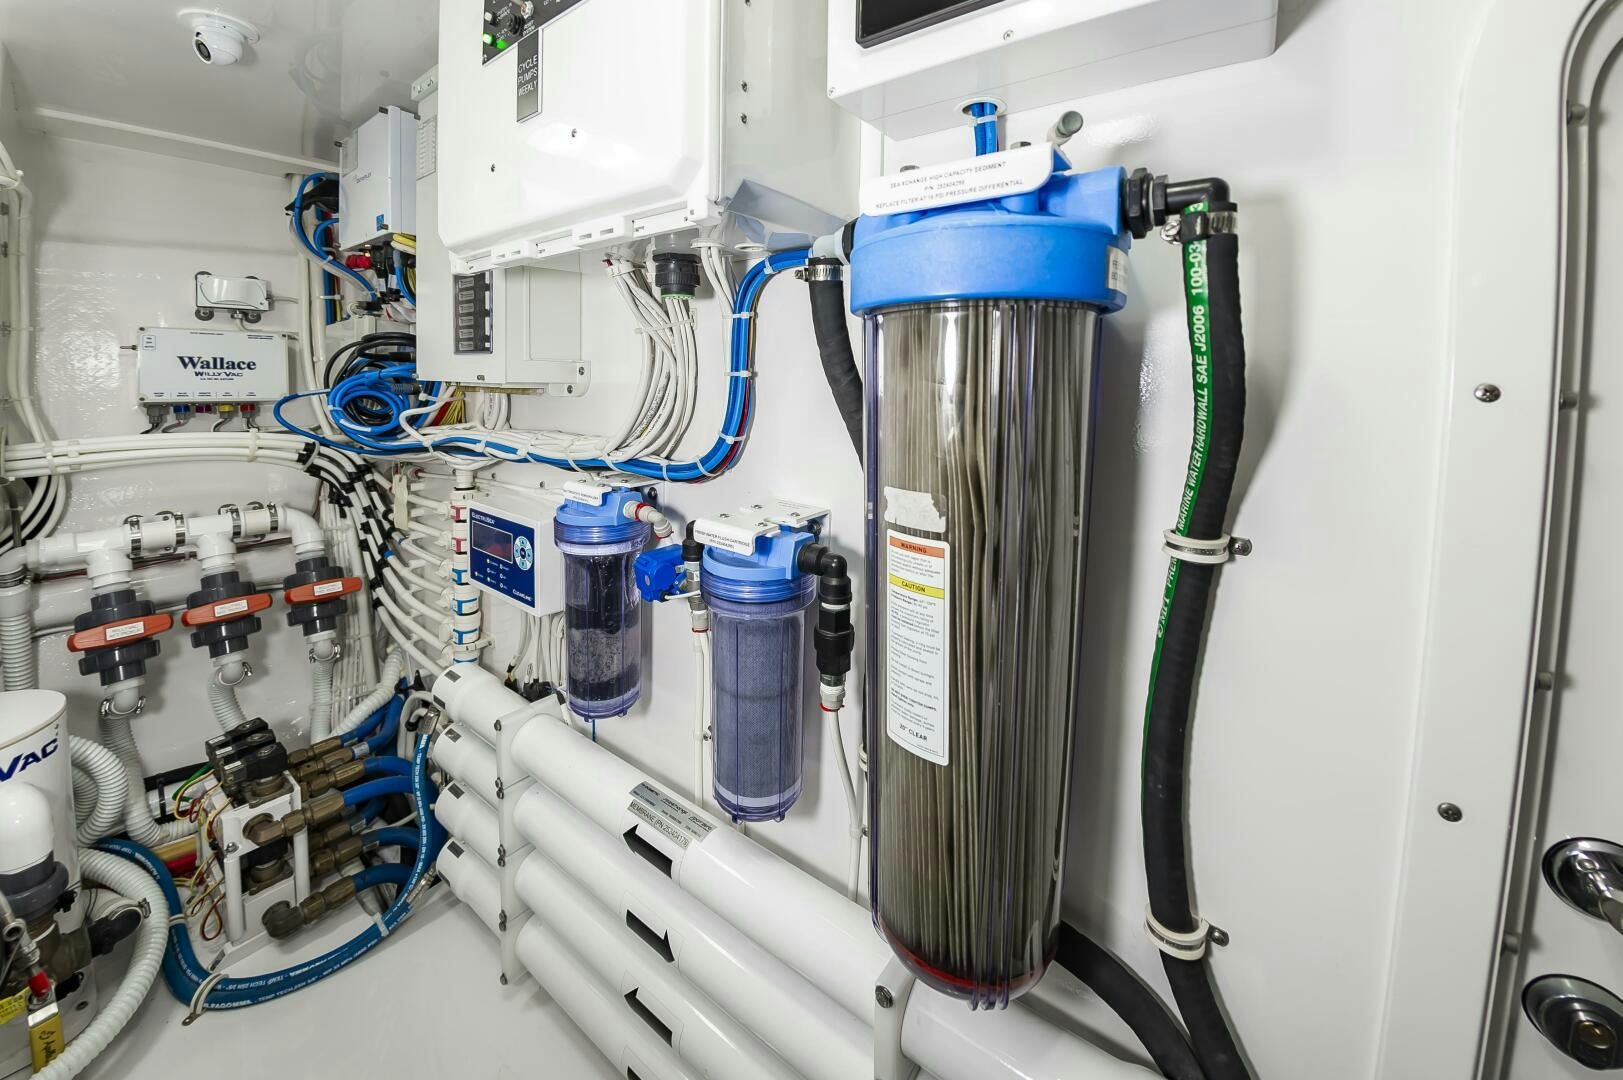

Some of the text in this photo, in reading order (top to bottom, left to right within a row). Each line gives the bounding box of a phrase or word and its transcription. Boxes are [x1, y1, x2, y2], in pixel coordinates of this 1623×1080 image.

[518, 54, 538, 74] CYCLE
[517, 67, 538, 86] PUMPS
[518, 80, 538, 97] WEEKLY
[974, 161, 1007, 174] SEDIMENT
[945, 186, 978, 198] PRESSURE
[978, 178, 1024, 193] DIFFERENTIAL
[1192, 304, 1208, 352] J2006
[177, 355, 257, 371] Wallace
[1196, 354, 1208, 385] SAE
[1195, 387, 1208, 453] HARDWALL
[1189, 454, 1203, 487] WATER
[1176, 487, 1194, 532] MARINE
[900, 542, 927, 554] WARNING
[901, 580, 926, 593] CAUTION
[908, 727, 928, 742] CLEAR
[0, 738, 59, 782] VAC
